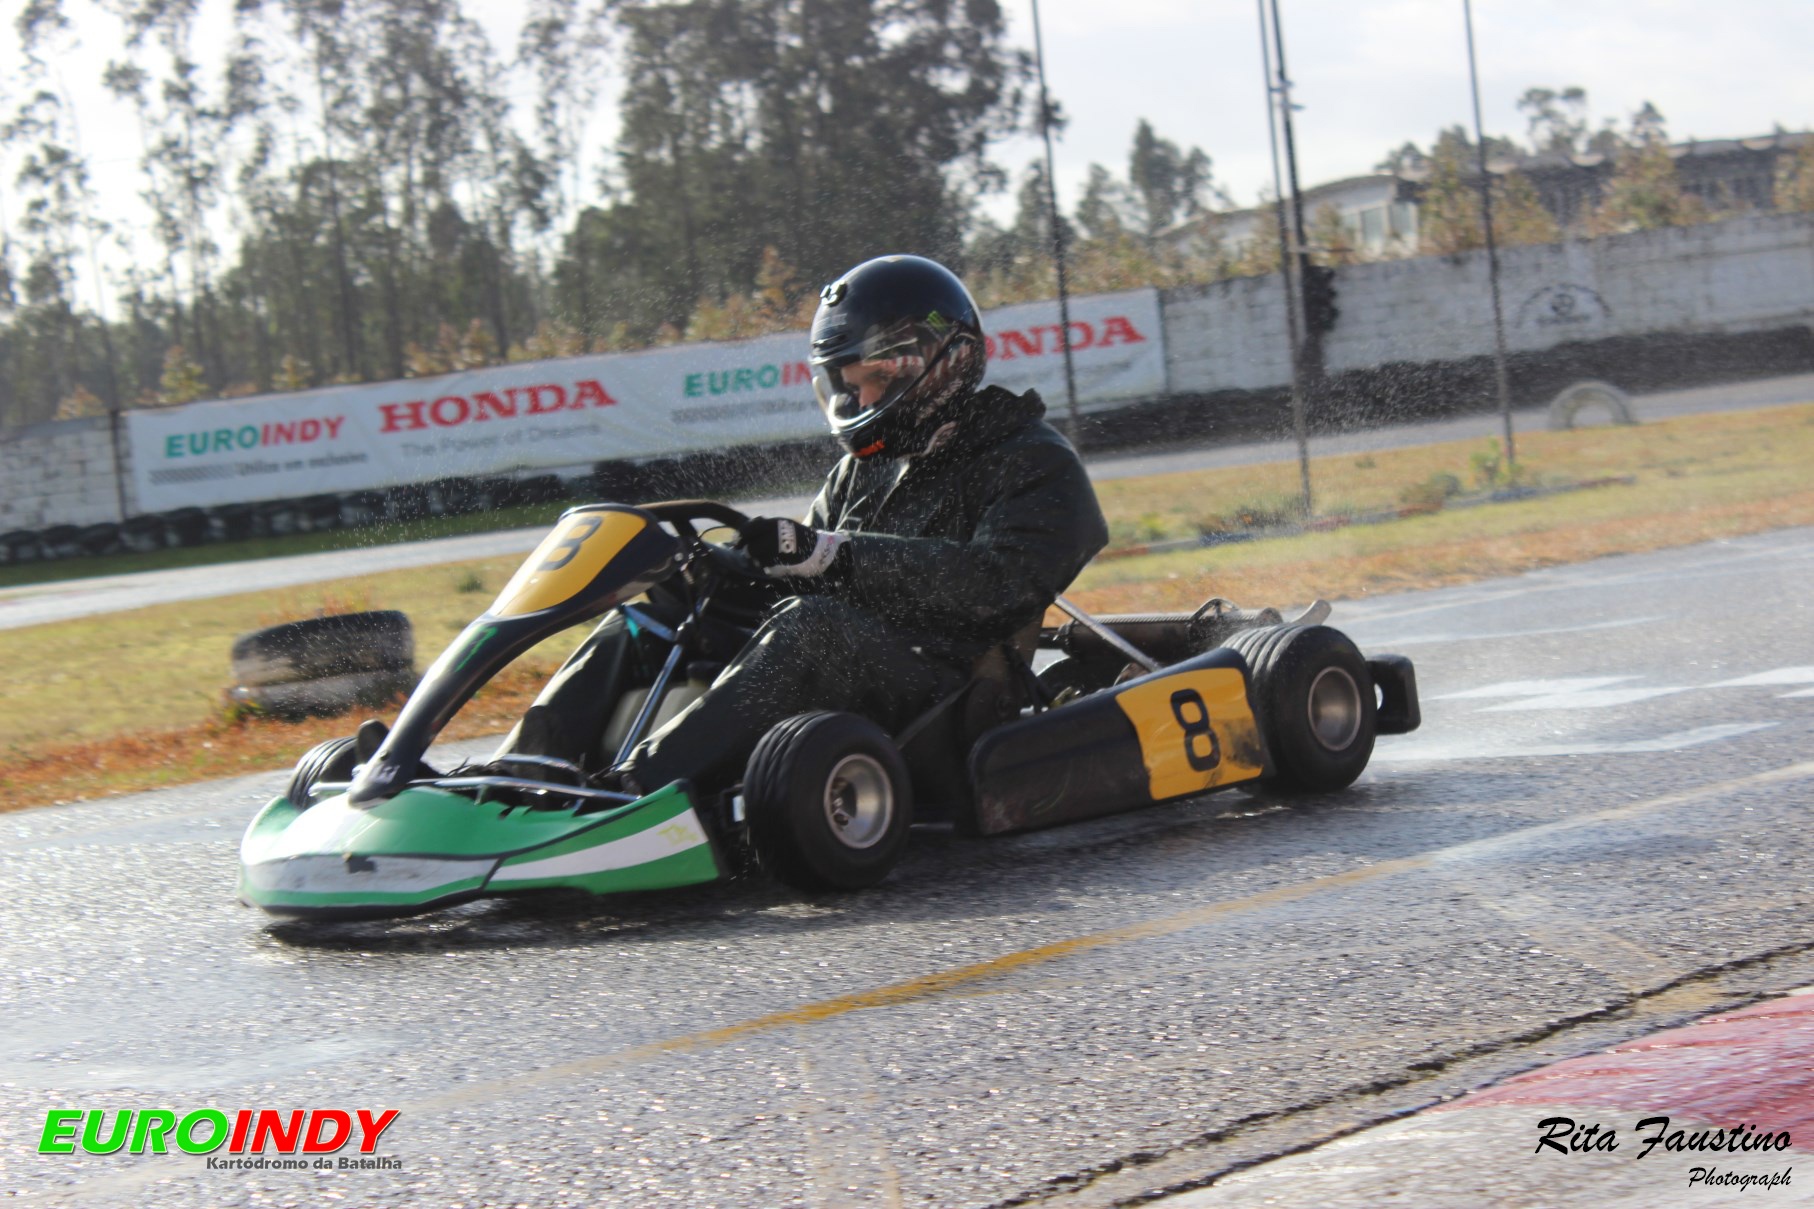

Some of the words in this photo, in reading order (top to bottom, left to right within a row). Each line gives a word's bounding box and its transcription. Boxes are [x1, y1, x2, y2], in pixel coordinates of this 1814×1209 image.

[985, 315, 1147, 361] NDA
[684, 362, 812, 397] EUROIN
[379, 379, 617, 435] HONDA
[164, 416, 345, 459] EUROINDY
[1170, 688, 1221, 772] 8
